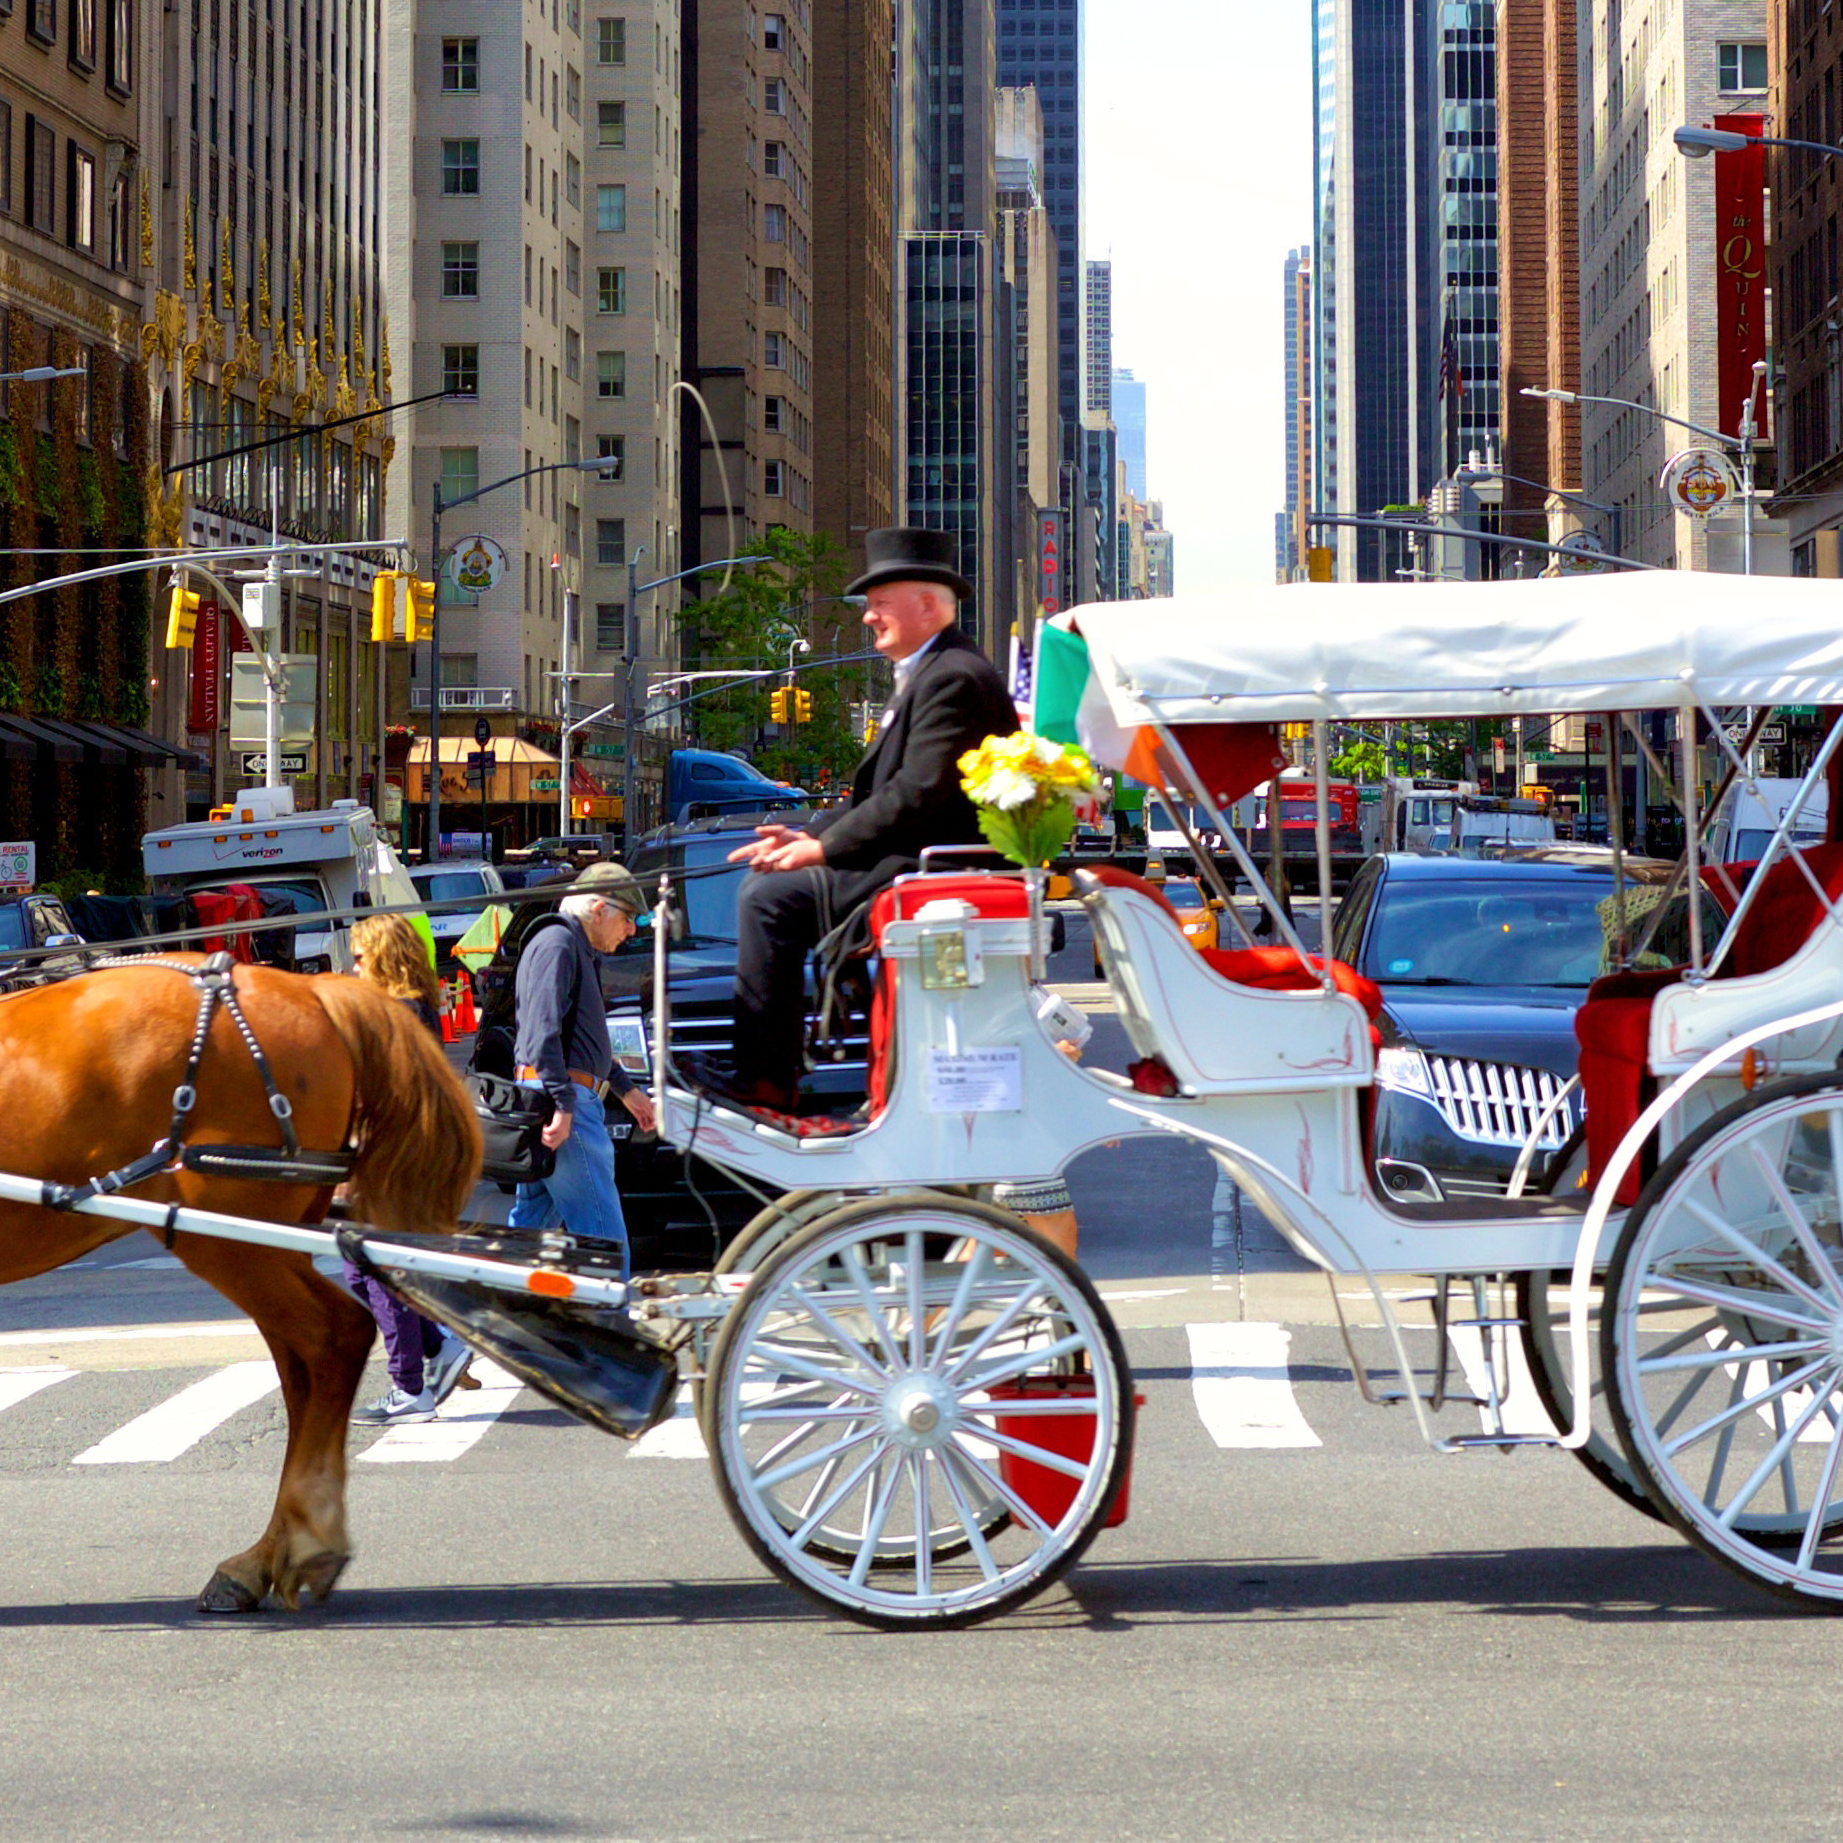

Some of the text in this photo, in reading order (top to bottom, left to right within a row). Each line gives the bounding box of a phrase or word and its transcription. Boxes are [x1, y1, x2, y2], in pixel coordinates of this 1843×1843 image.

[1732, 215, 1750, 227] the
[1043, 520, 1059, 613] RADIO
[204, 606, 216, 724] QUALITY ITALIAN
[1728, 729, 1748, 738] ONE
[2, 845, 29, 855] RENTAL
[242, 846, 283, 859] verizon
